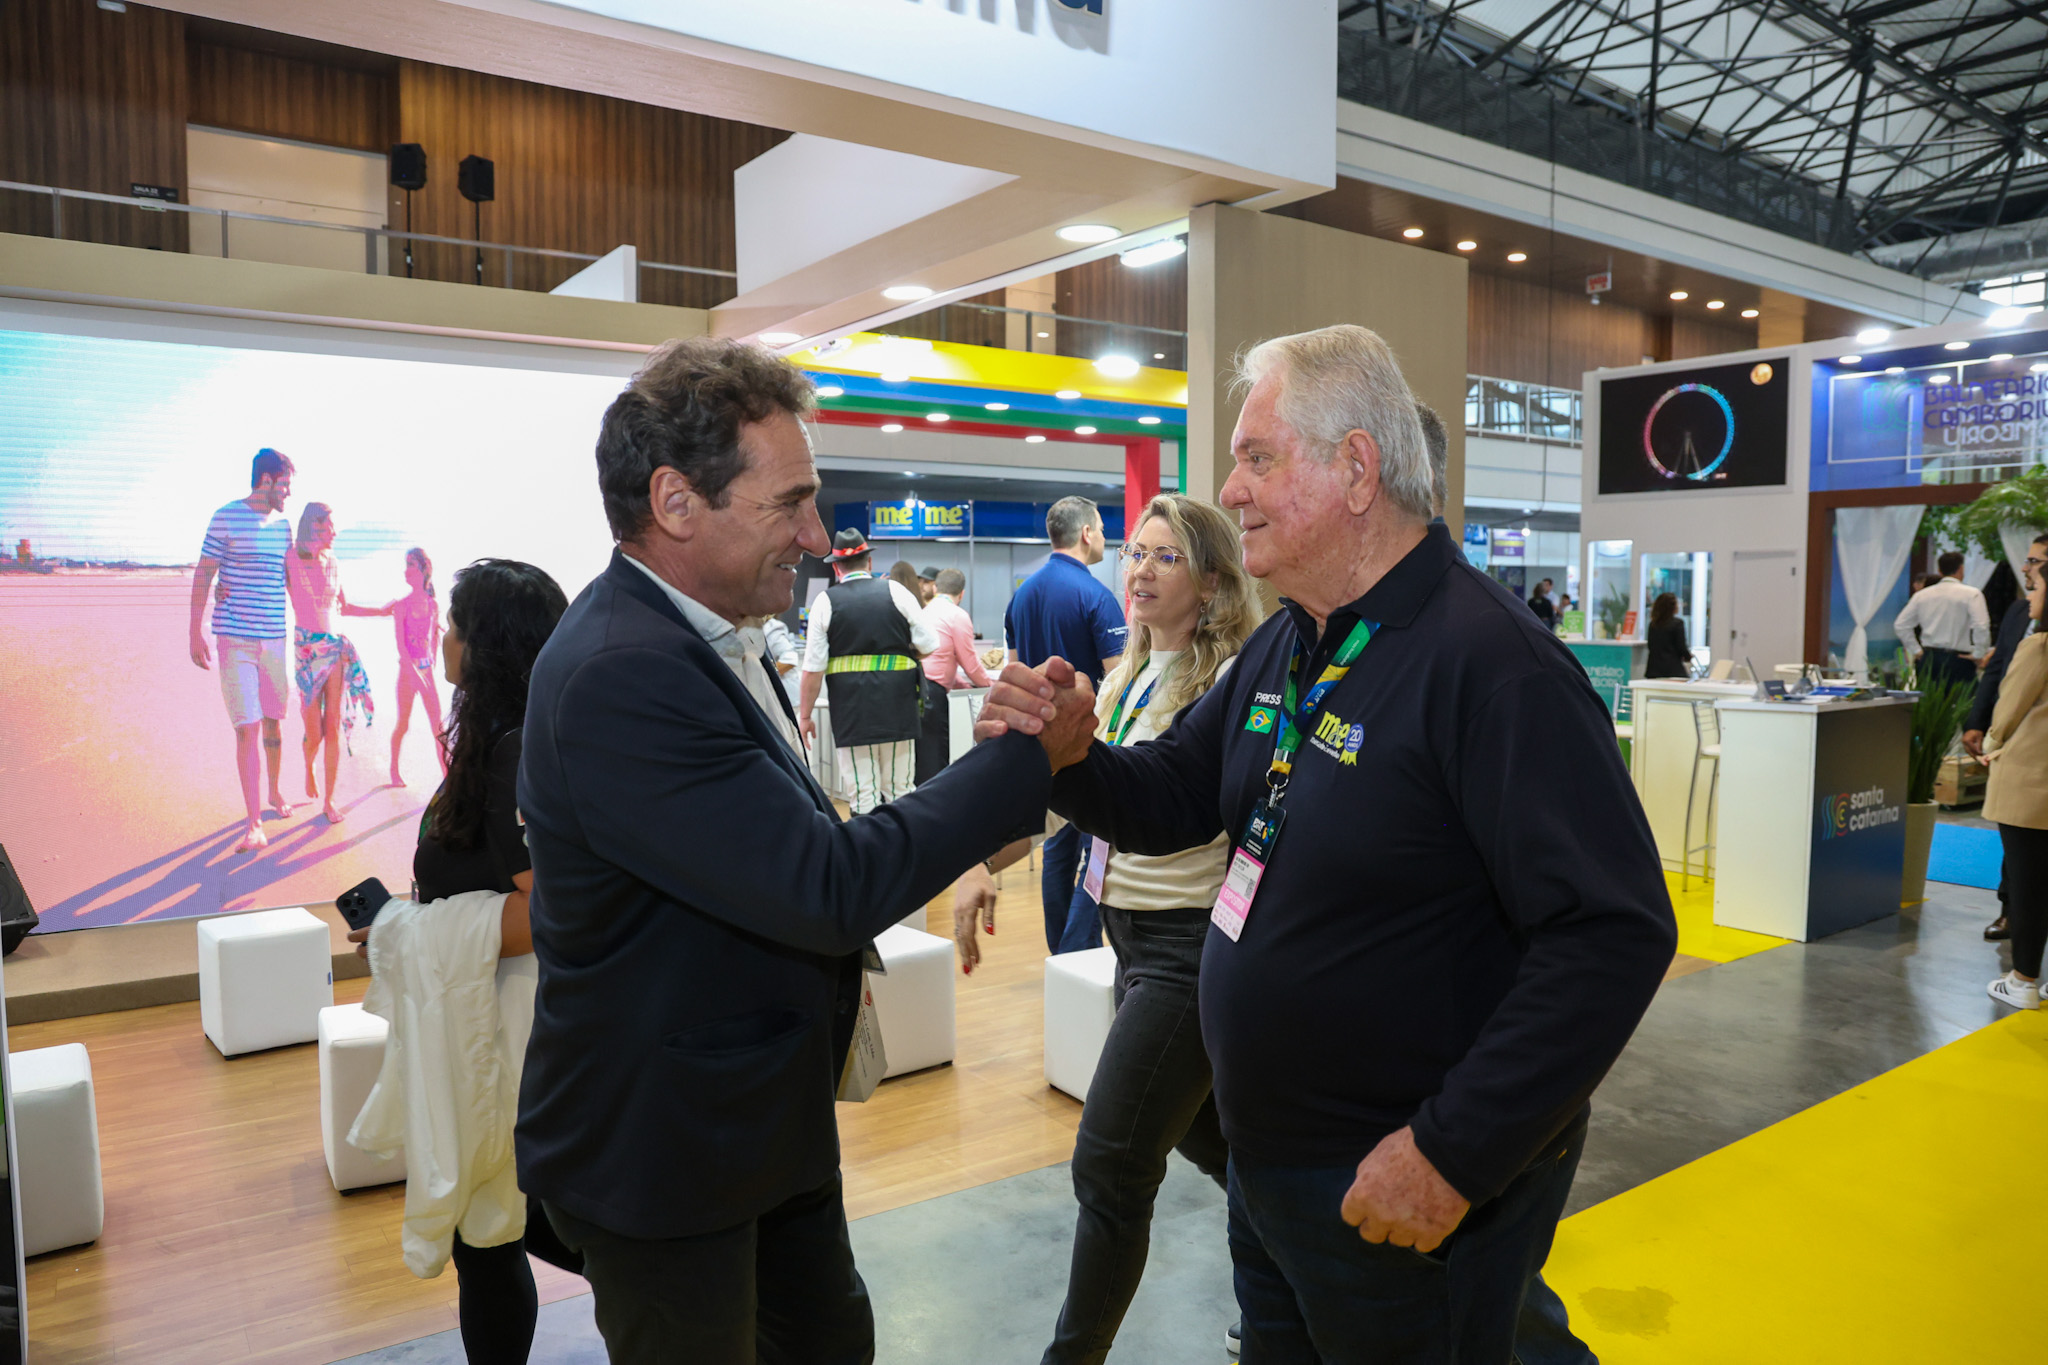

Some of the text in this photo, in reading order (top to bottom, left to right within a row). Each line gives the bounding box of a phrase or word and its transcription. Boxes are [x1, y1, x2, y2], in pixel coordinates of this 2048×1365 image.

[1924, 371, 2048, 406] BALNEÁRI
[1254, 692, 1282, 705] PRESS
[1349, 728, 1361, 742] 20
[1850, 785, 1884, 809] santa
[1849, 804, 1899, 831] catarina
